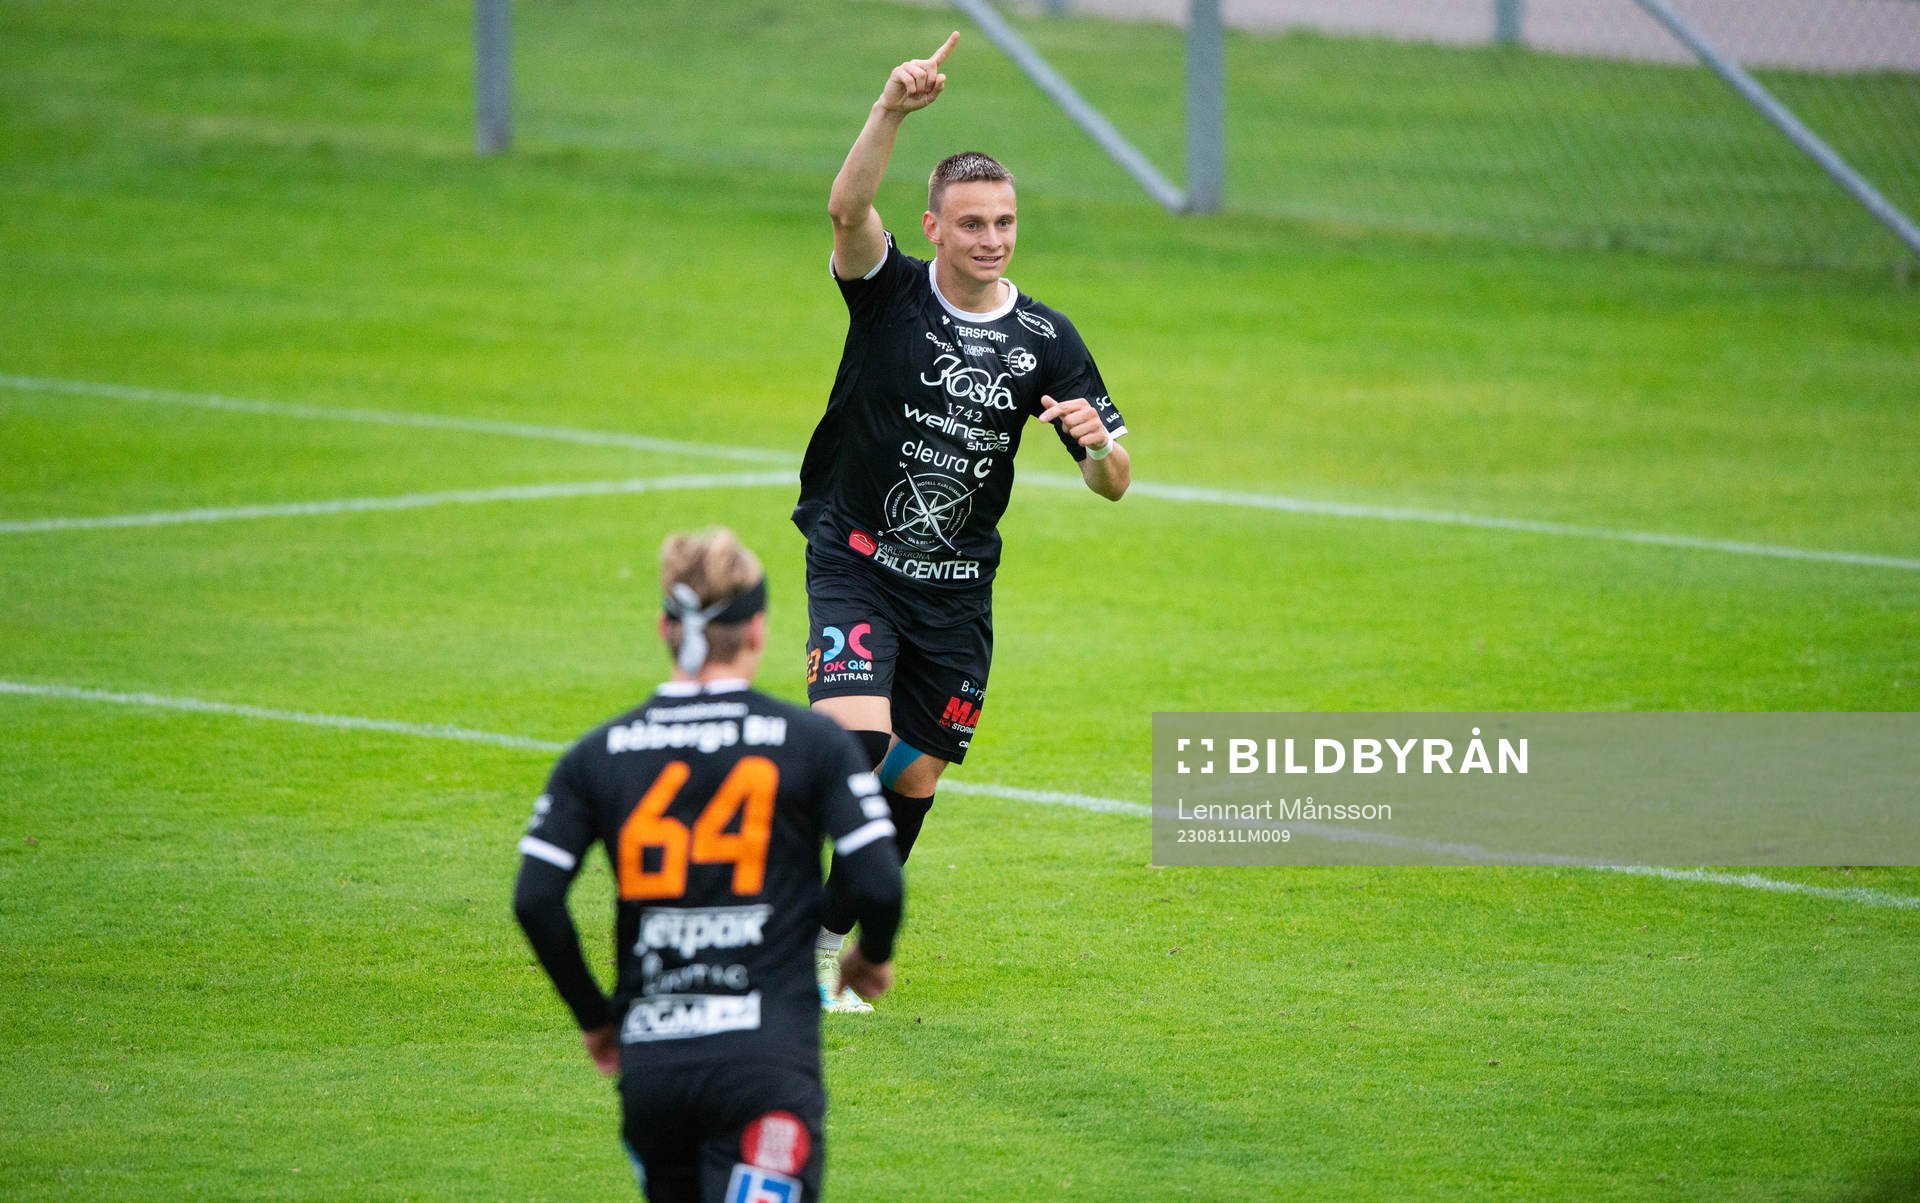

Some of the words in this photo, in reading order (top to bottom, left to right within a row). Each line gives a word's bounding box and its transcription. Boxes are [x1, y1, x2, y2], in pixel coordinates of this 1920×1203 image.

[942, 315, 1009, 343] TERSPORT
[904, 403, 1011, 445] wellness
[947, 402, 983, 423] 1742
[901, 440, 969, 474] cleura
[966, 440, 1009, 453] studio
[874, 547, 980, 580] BILCENTER
[877, 541, 931, 561] KARLSKRONA
[823, 672, 874, 683] NÄTTRABY
[617, 755, 780, 900] 64
